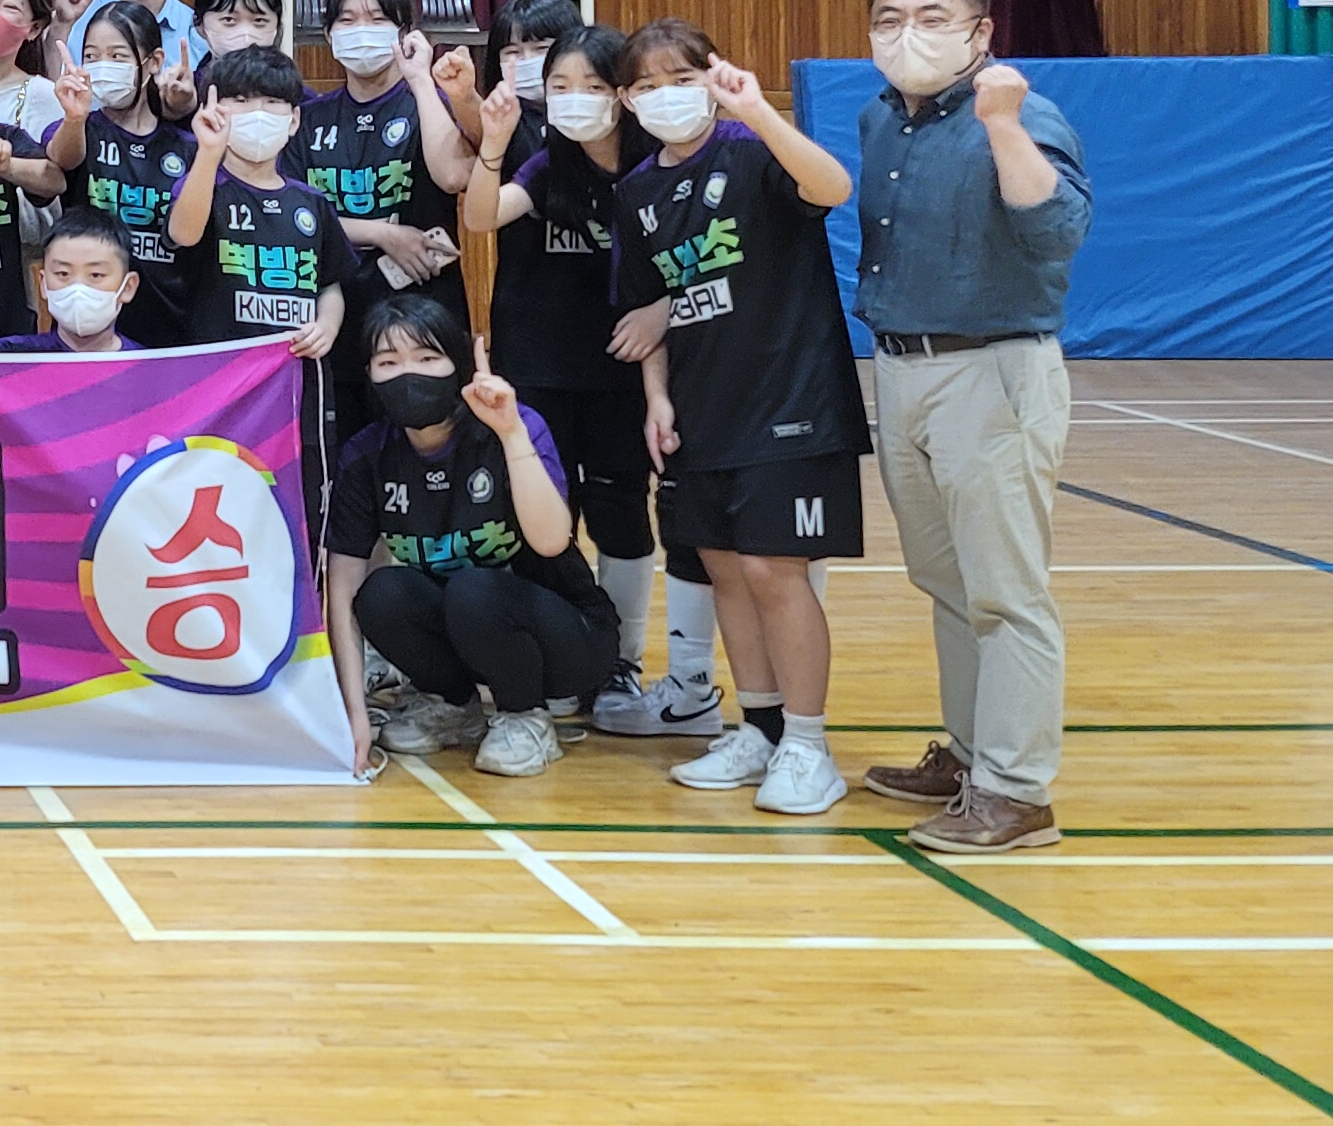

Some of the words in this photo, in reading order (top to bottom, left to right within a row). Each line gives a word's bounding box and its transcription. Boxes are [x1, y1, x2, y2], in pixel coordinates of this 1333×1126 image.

[96, 140, 121, 166] 10
[309, 124, 339, 152] 14
[87, 173, 171, 226] 벽방
[228, 204, 256, 231] 12
[384, 481, 410, 515] 24
[794, 496, 825, 538] M
[143, 484, 250, 661] 승
